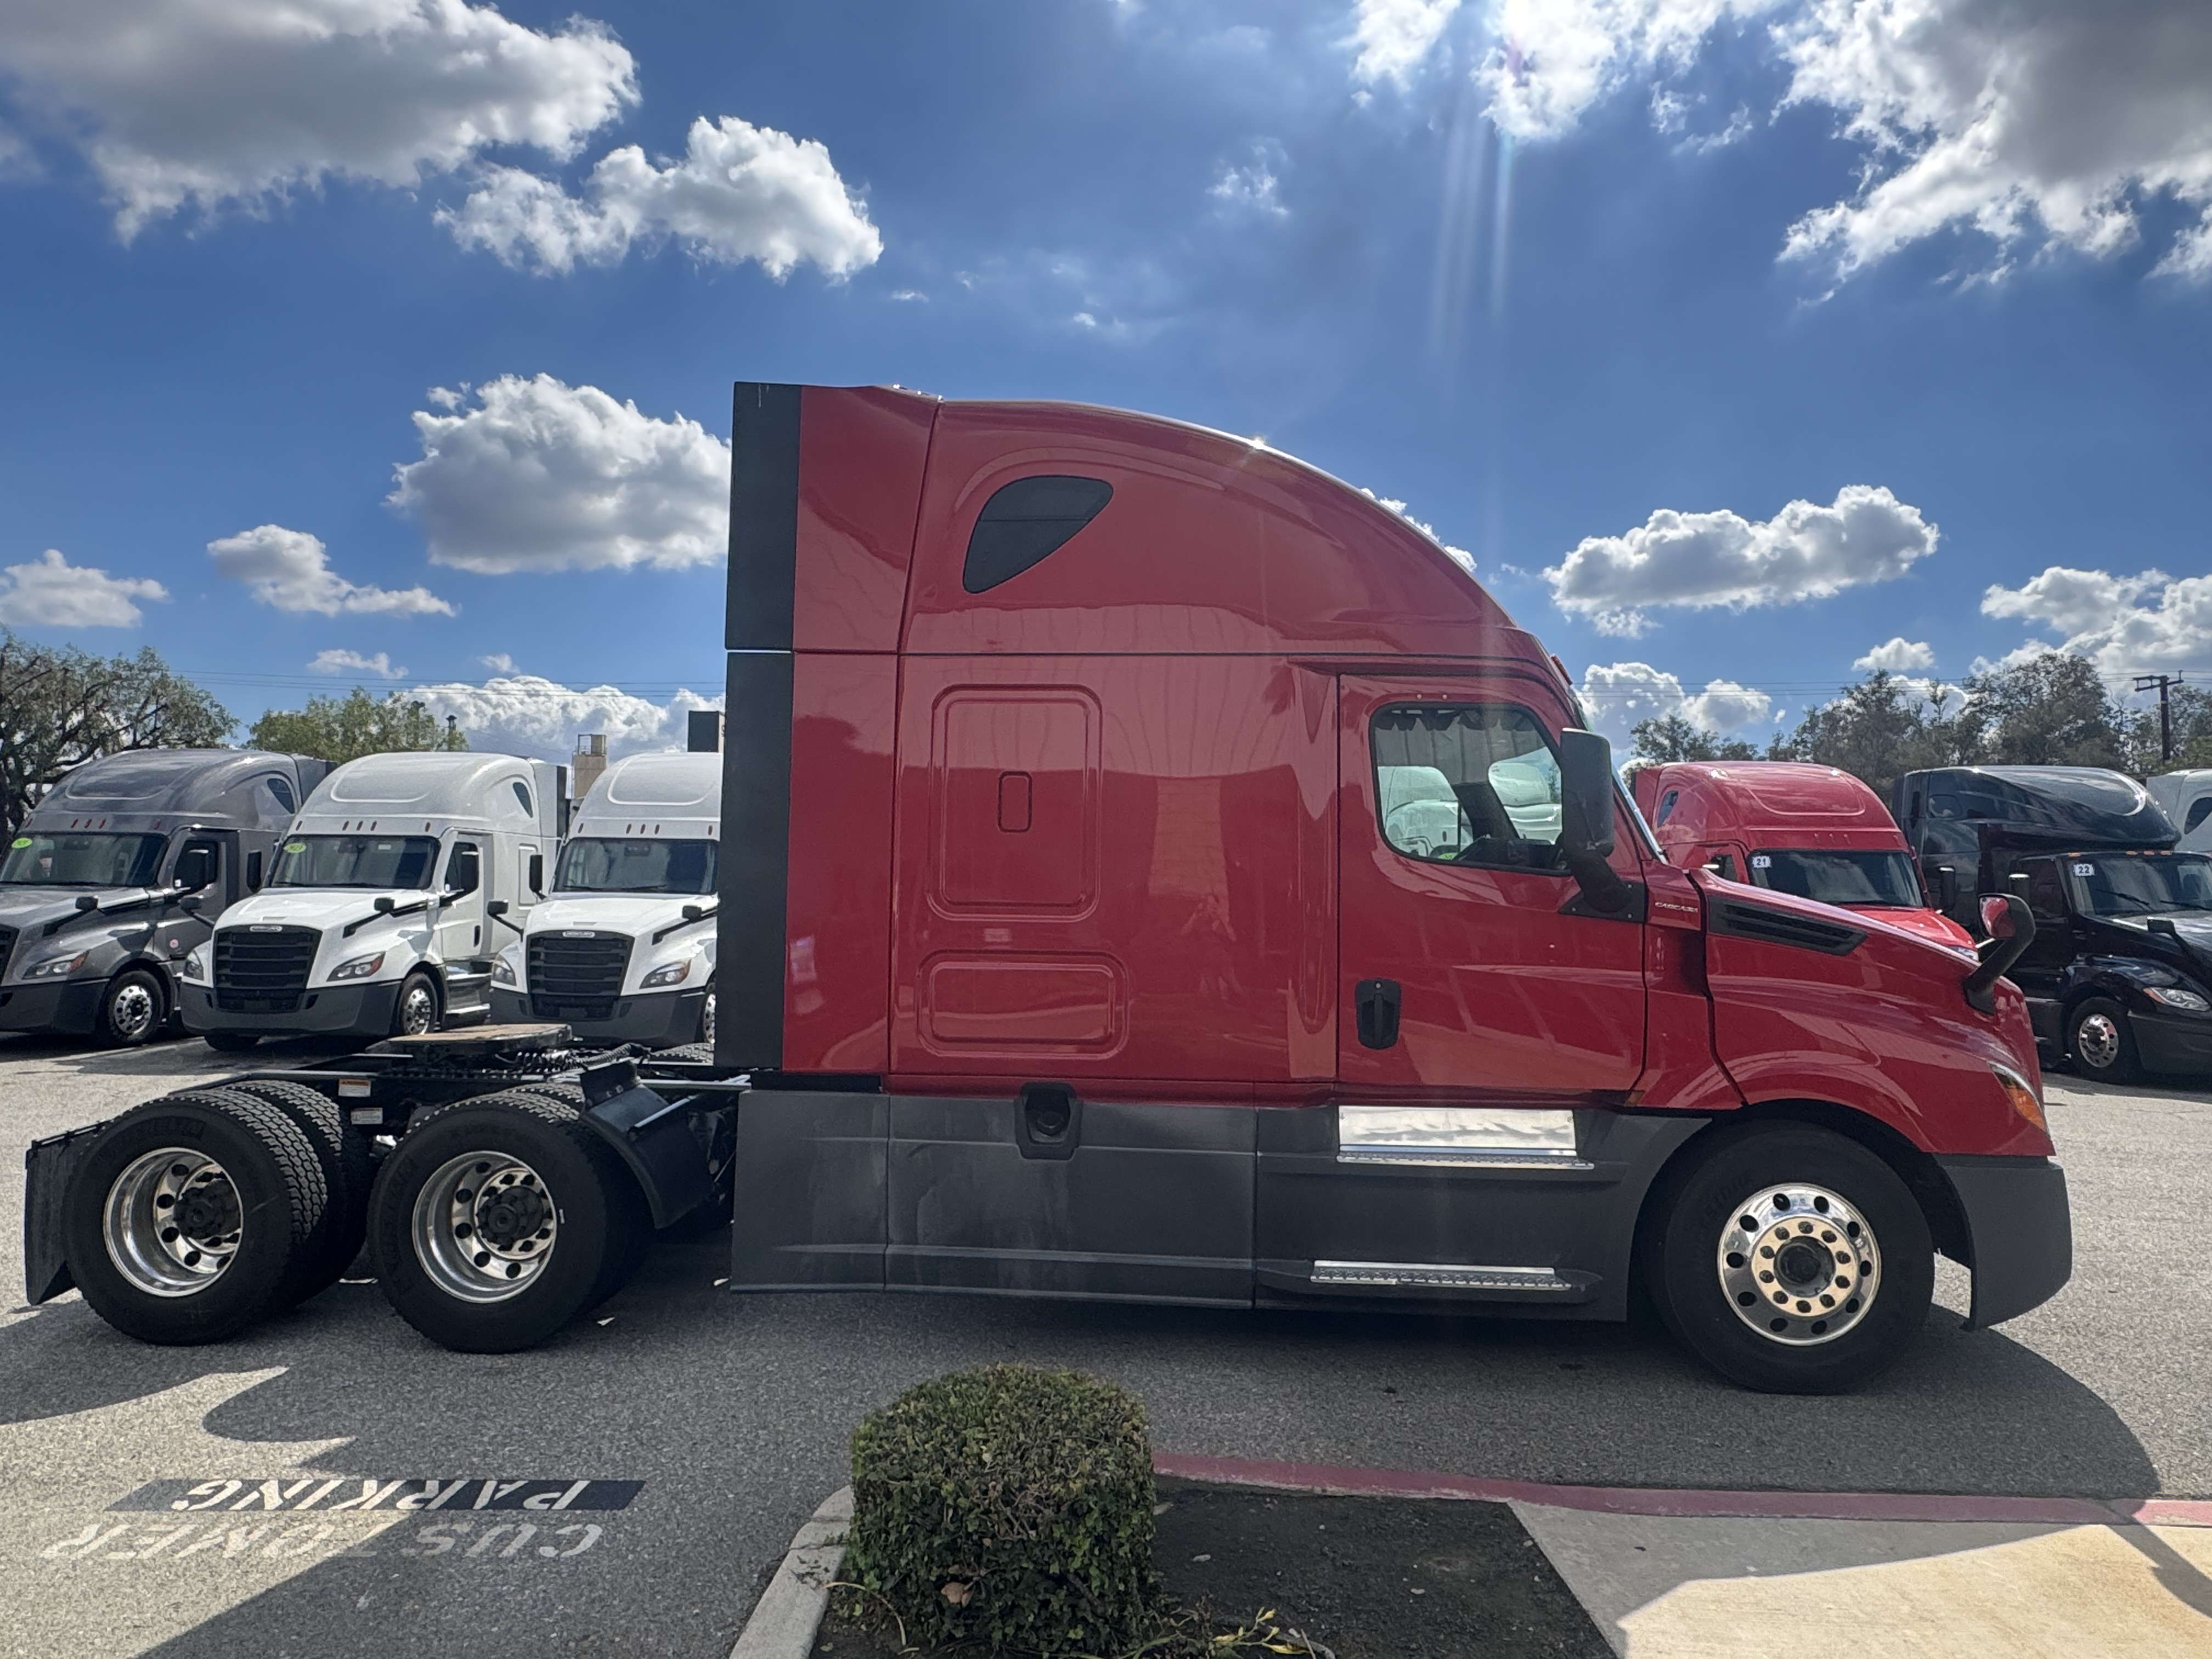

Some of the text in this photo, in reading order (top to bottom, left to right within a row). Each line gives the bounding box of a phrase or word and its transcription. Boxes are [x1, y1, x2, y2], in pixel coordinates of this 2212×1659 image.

[1757, 857, 1767, 866] 21
[2078, 865, 2089, 873] 22
[171, 1480, 591, 1510] PARKING
[40, 1523, 603, 1559] CUSTOMER
